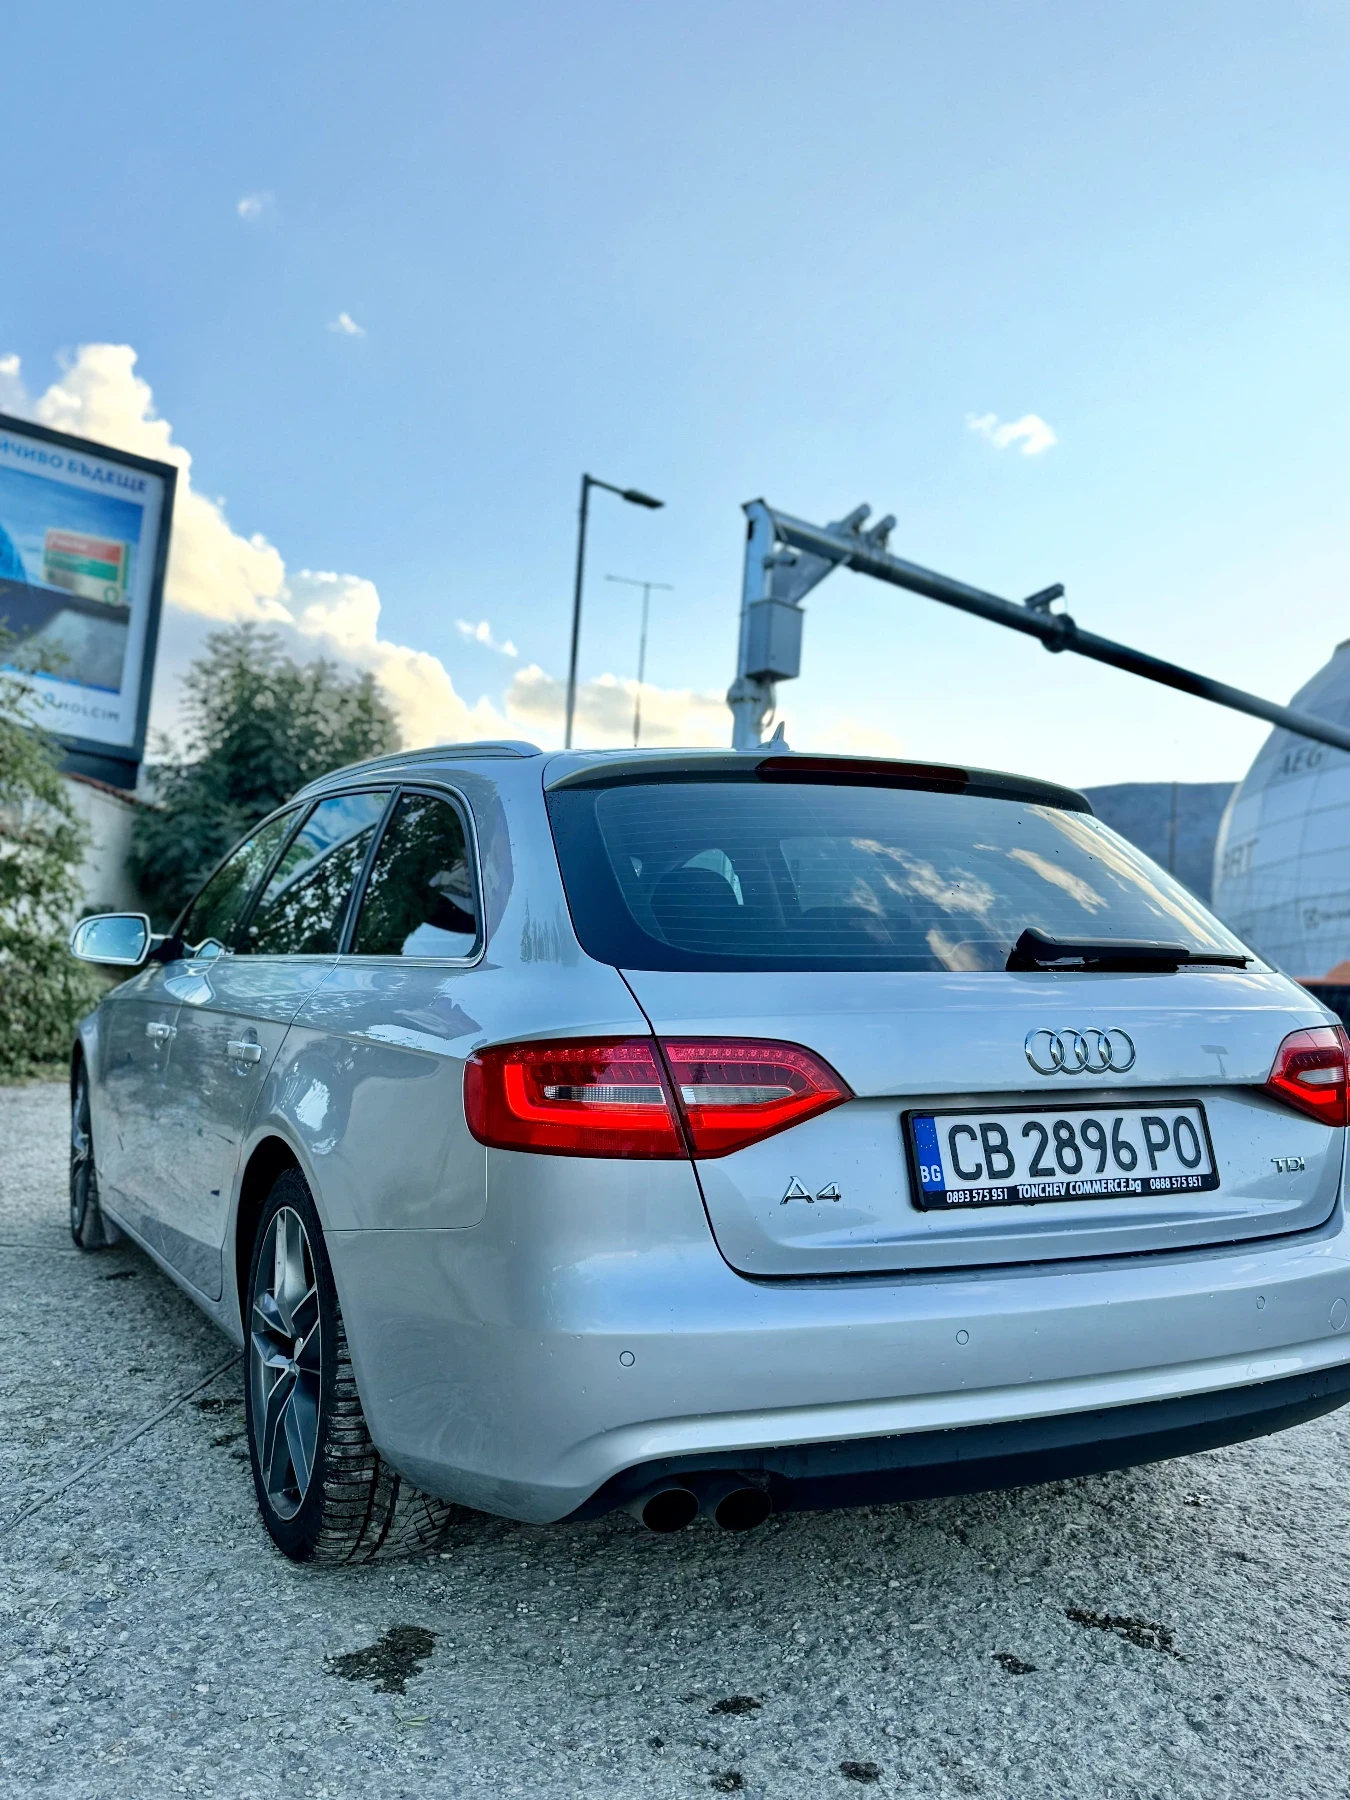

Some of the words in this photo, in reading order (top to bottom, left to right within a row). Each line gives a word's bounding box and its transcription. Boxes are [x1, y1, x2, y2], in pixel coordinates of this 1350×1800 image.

[949, 1123, 1015, 1180] CB
[1021, 1117, 1138, 1178] 2896
[1141, 1115, 1201, 1171] PO
[920, 1165, 941, 1182] BG
[1270, 1156, 1305, 1173] TDI
[780, 1176, 841, 1205] A4
[946, 1190, 970, 1203] 0893
[972, 1189, 989, 1201] 575
[992, 1188, 1008, 1200] 951
[1016, 1182, 1066, 1199] TONCHEV
[1069, 1178, 1141, 1195] COMMERCE.bg
[1150, 1177, 1171, 1190] 0888
[1171, 1176, 1187, 1188] 575
[1187, 1176, 1202, 1187] 951
